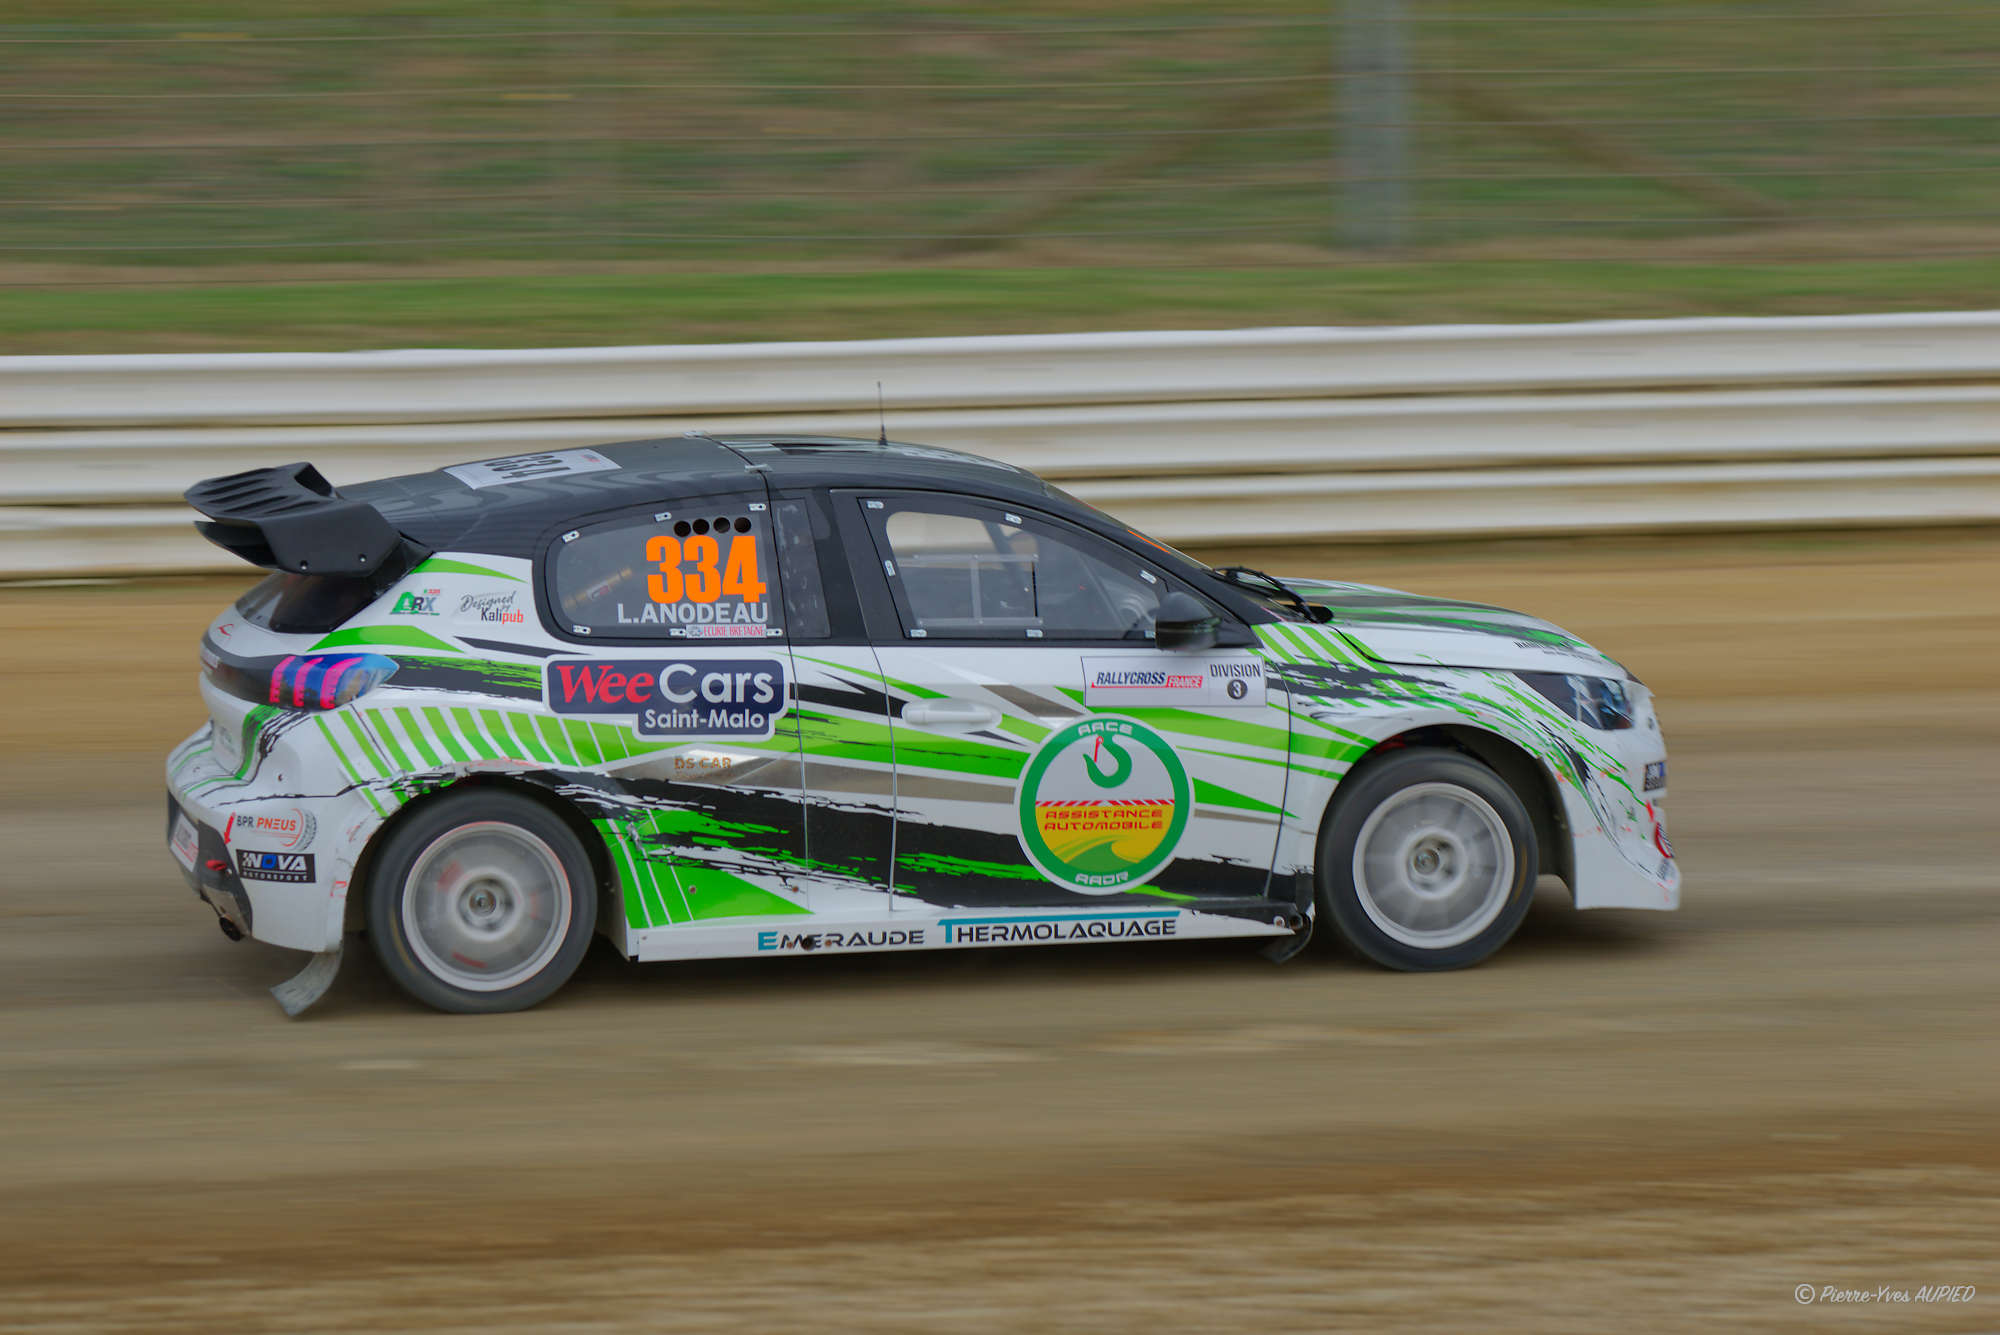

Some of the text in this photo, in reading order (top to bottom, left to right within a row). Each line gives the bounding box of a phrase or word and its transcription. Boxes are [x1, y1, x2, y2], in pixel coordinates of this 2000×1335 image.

[646, 535, 767, 604] 334
[481, 607, 524, 624] Kalipub
[617, 602, 768, 624] L.ANODEAU
[704, 626, 727, 637] ECURIE
[729, 625, 763, 637] BRETAGNE
[1210, 664, 1260, 677] DIVISION
[1096, 671, 1202, 689] RALLYCROSS FRANCE
[644, 708, 765, 729] Saint-Malo
[674, 757, 732, 769] DS CAR
[1045, 808, 1163, 819] ASSISTANCE
[237, 815, 297, 831] BPR PNEUS
[1044, 820, 1163, 831] AUTOMOBILE
[937, 910, 1180, 943] THERMOLAQUAGE
